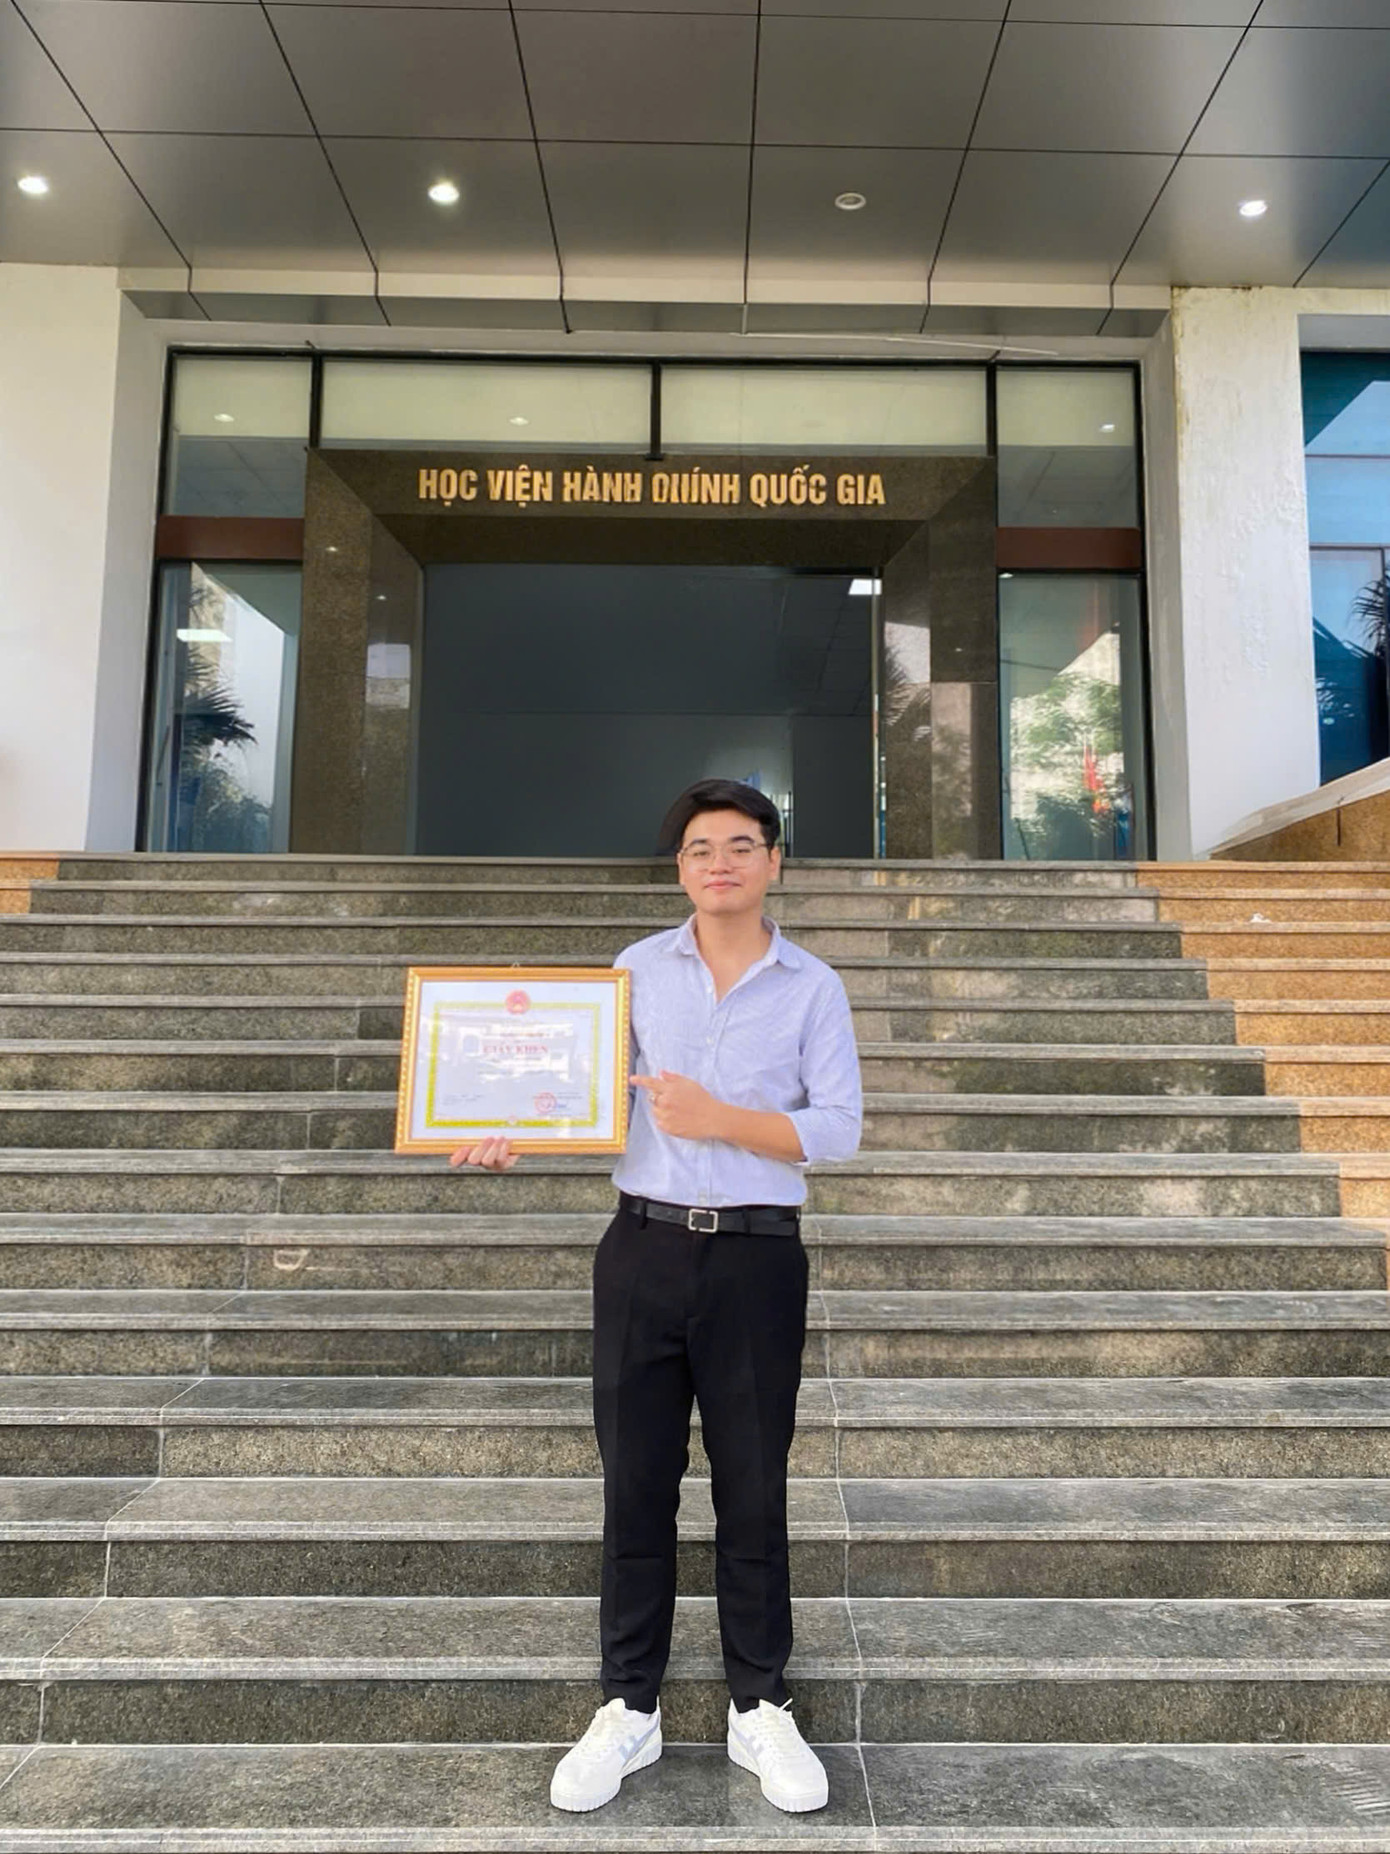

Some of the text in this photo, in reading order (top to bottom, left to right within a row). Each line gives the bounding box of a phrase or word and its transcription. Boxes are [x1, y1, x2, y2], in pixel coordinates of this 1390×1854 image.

[418, 468, 478, 507] HỌC
[487, 463, 553, 508] VIỆN
[562, 465, 643, 503] HÀNH
[750, 464, 827, 508] QUỐC
[836, 473, 886, 505] GIA
